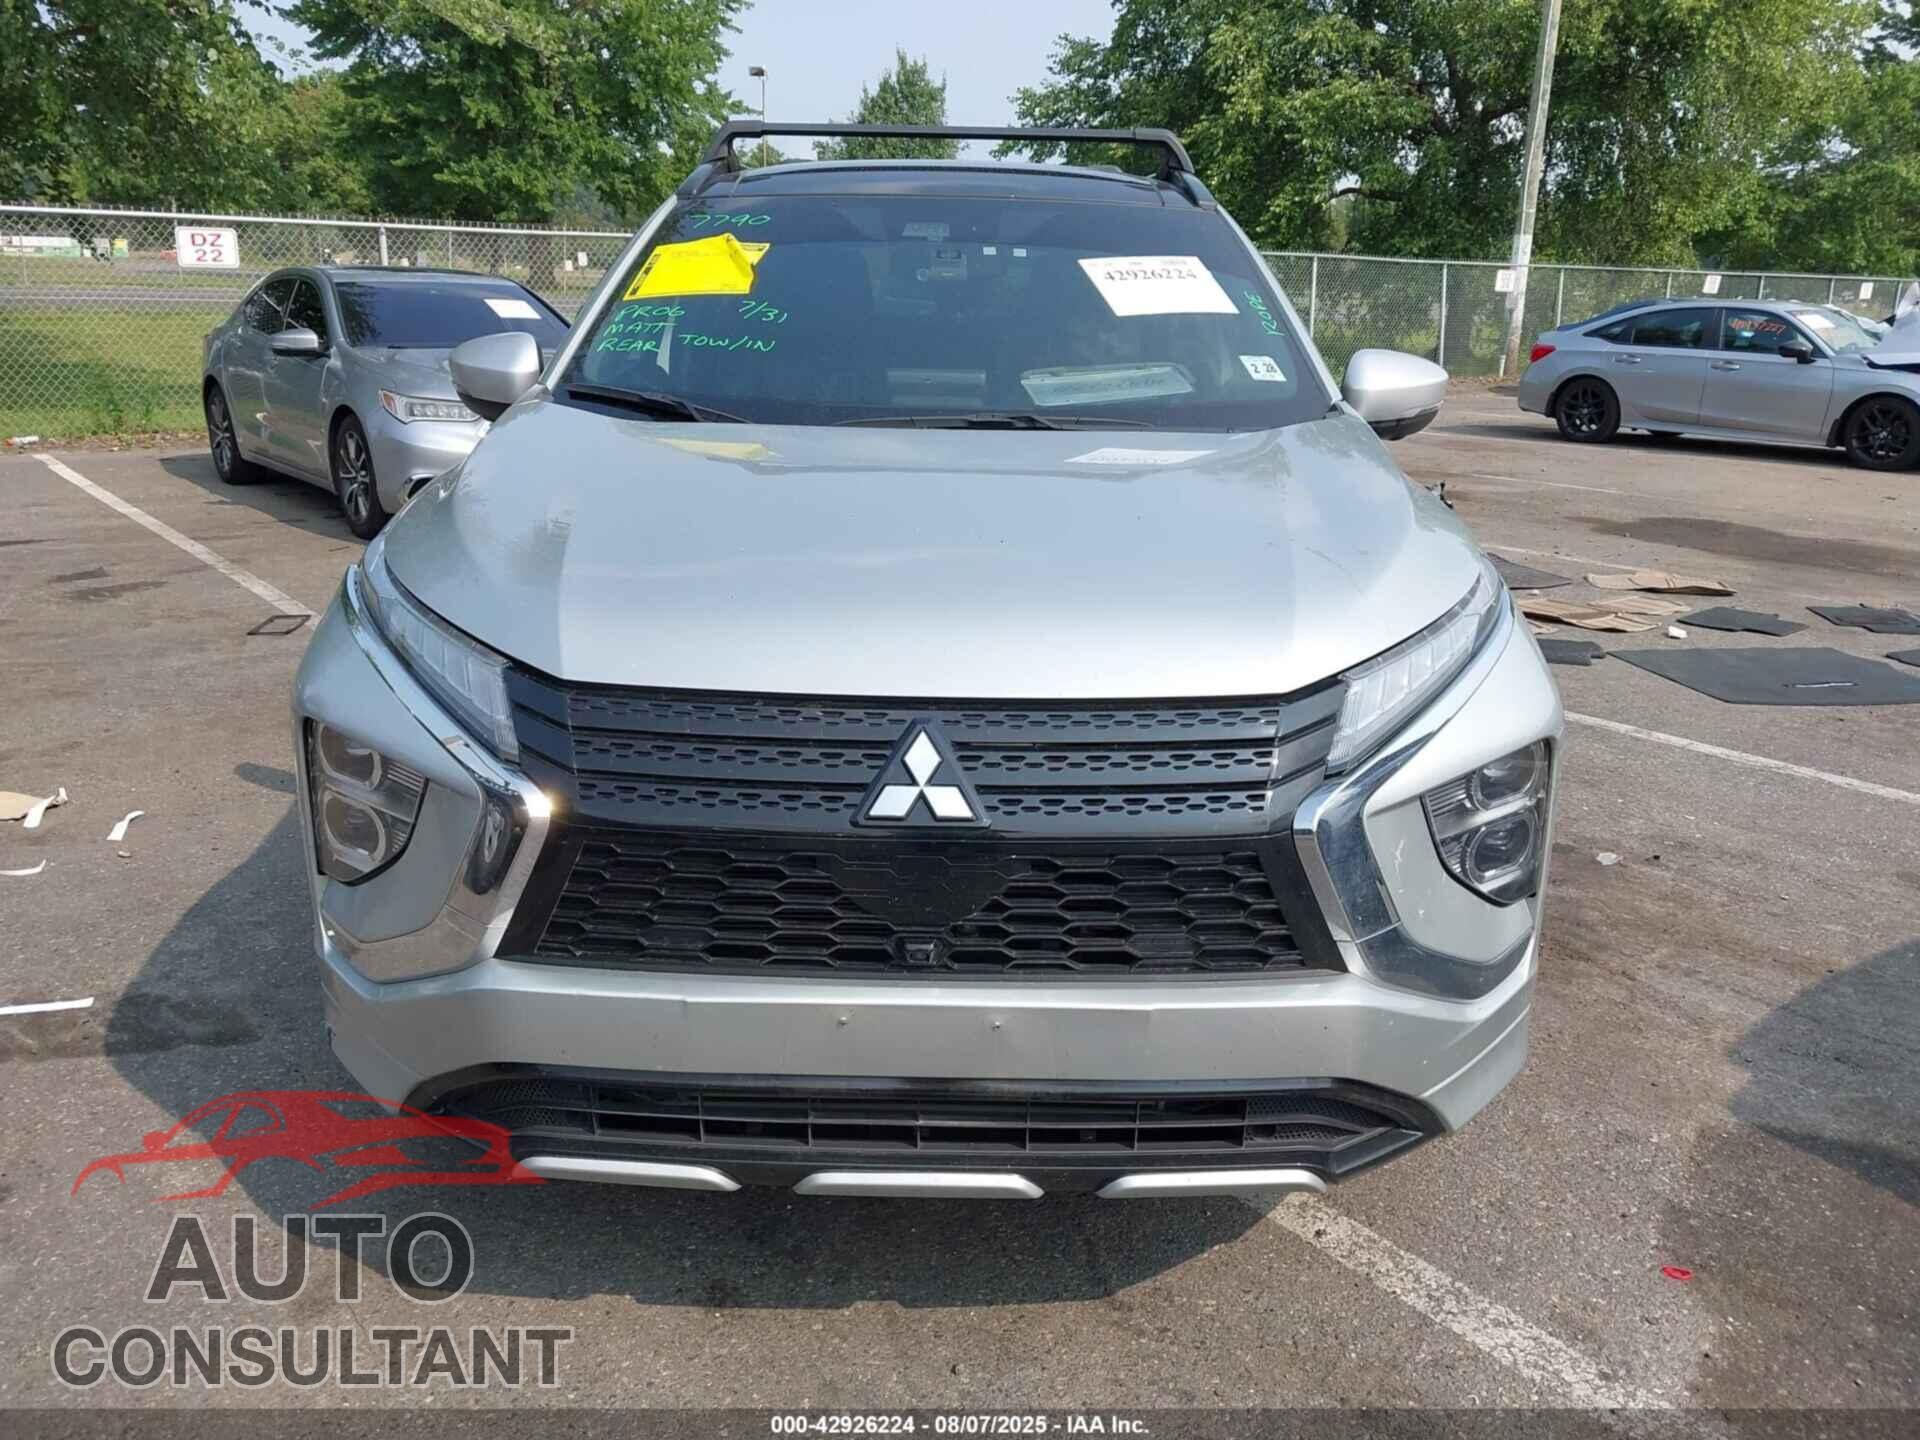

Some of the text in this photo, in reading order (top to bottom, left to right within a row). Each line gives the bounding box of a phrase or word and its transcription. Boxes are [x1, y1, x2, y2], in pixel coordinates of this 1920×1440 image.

[191, 232, 224, 247] DZ
[194, 248, 224, 262] 22
[1104, 267, 1198, 281] 42926224
[597, 338, 661, 352] REAR
